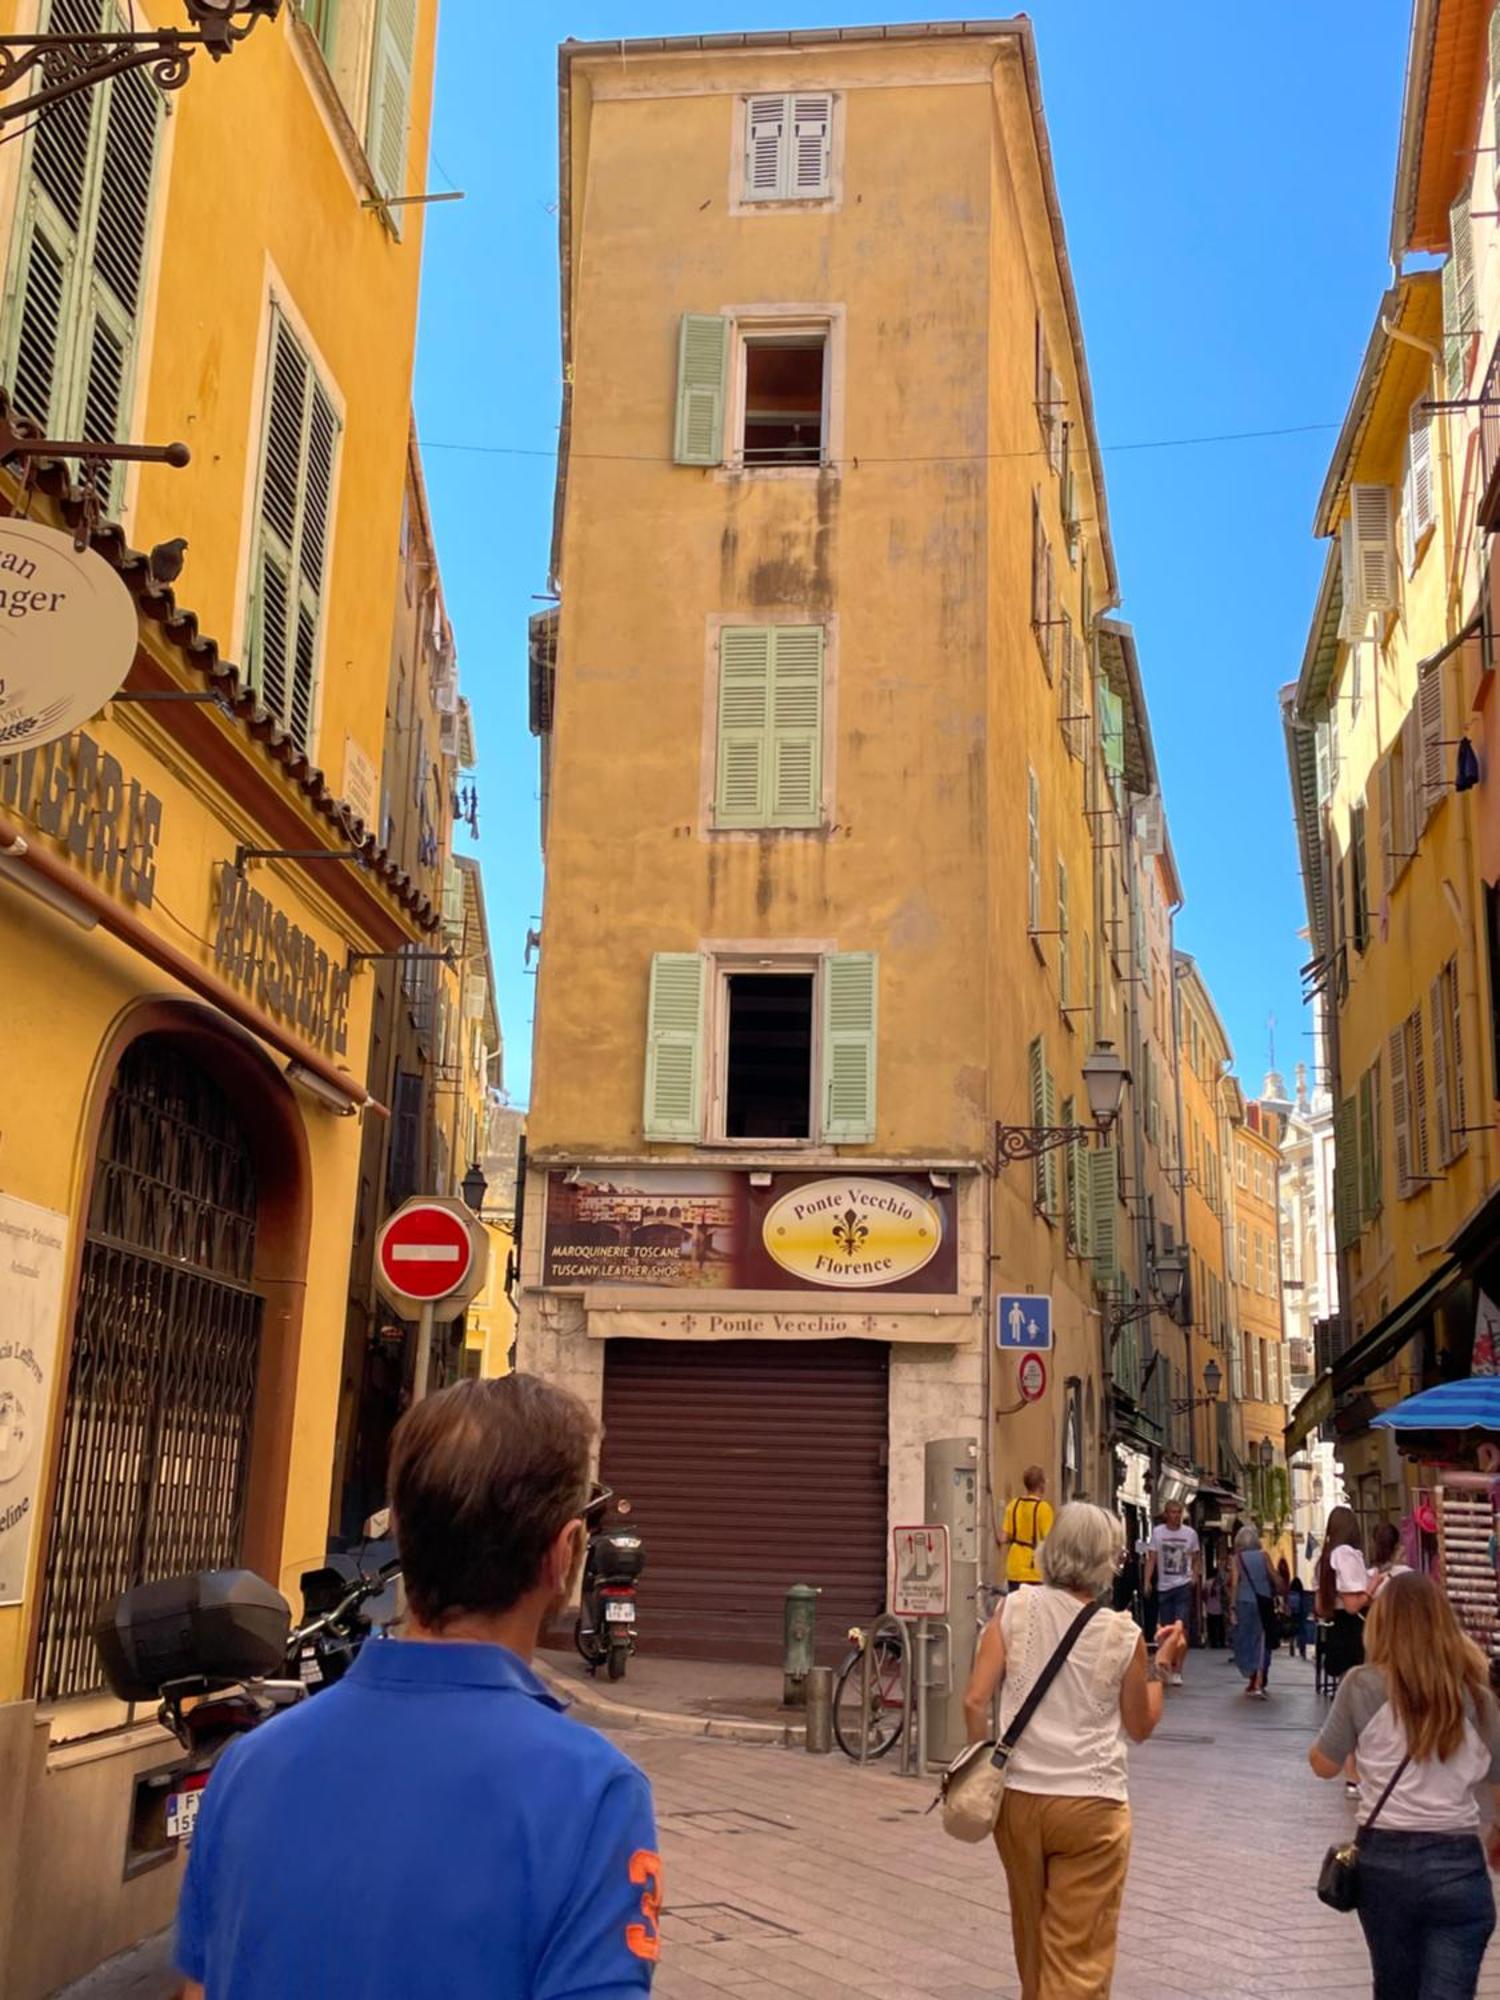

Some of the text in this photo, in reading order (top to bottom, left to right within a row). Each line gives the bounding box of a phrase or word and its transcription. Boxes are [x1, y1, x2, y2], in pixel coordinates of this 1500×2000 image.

[0, 551, 37, 580] an
[793, 1189, 914, 1221] Ponte Vecchio
[552, 1245, 681, 1259] MAROQUINERIE TOSCANE
[552, 1264, 680, 1277] TUSCANY LEATHER SHOP
[814, 1254, 893, 1275] Florence
[709, 1315, 847, 1333] Ponte Vecchio
